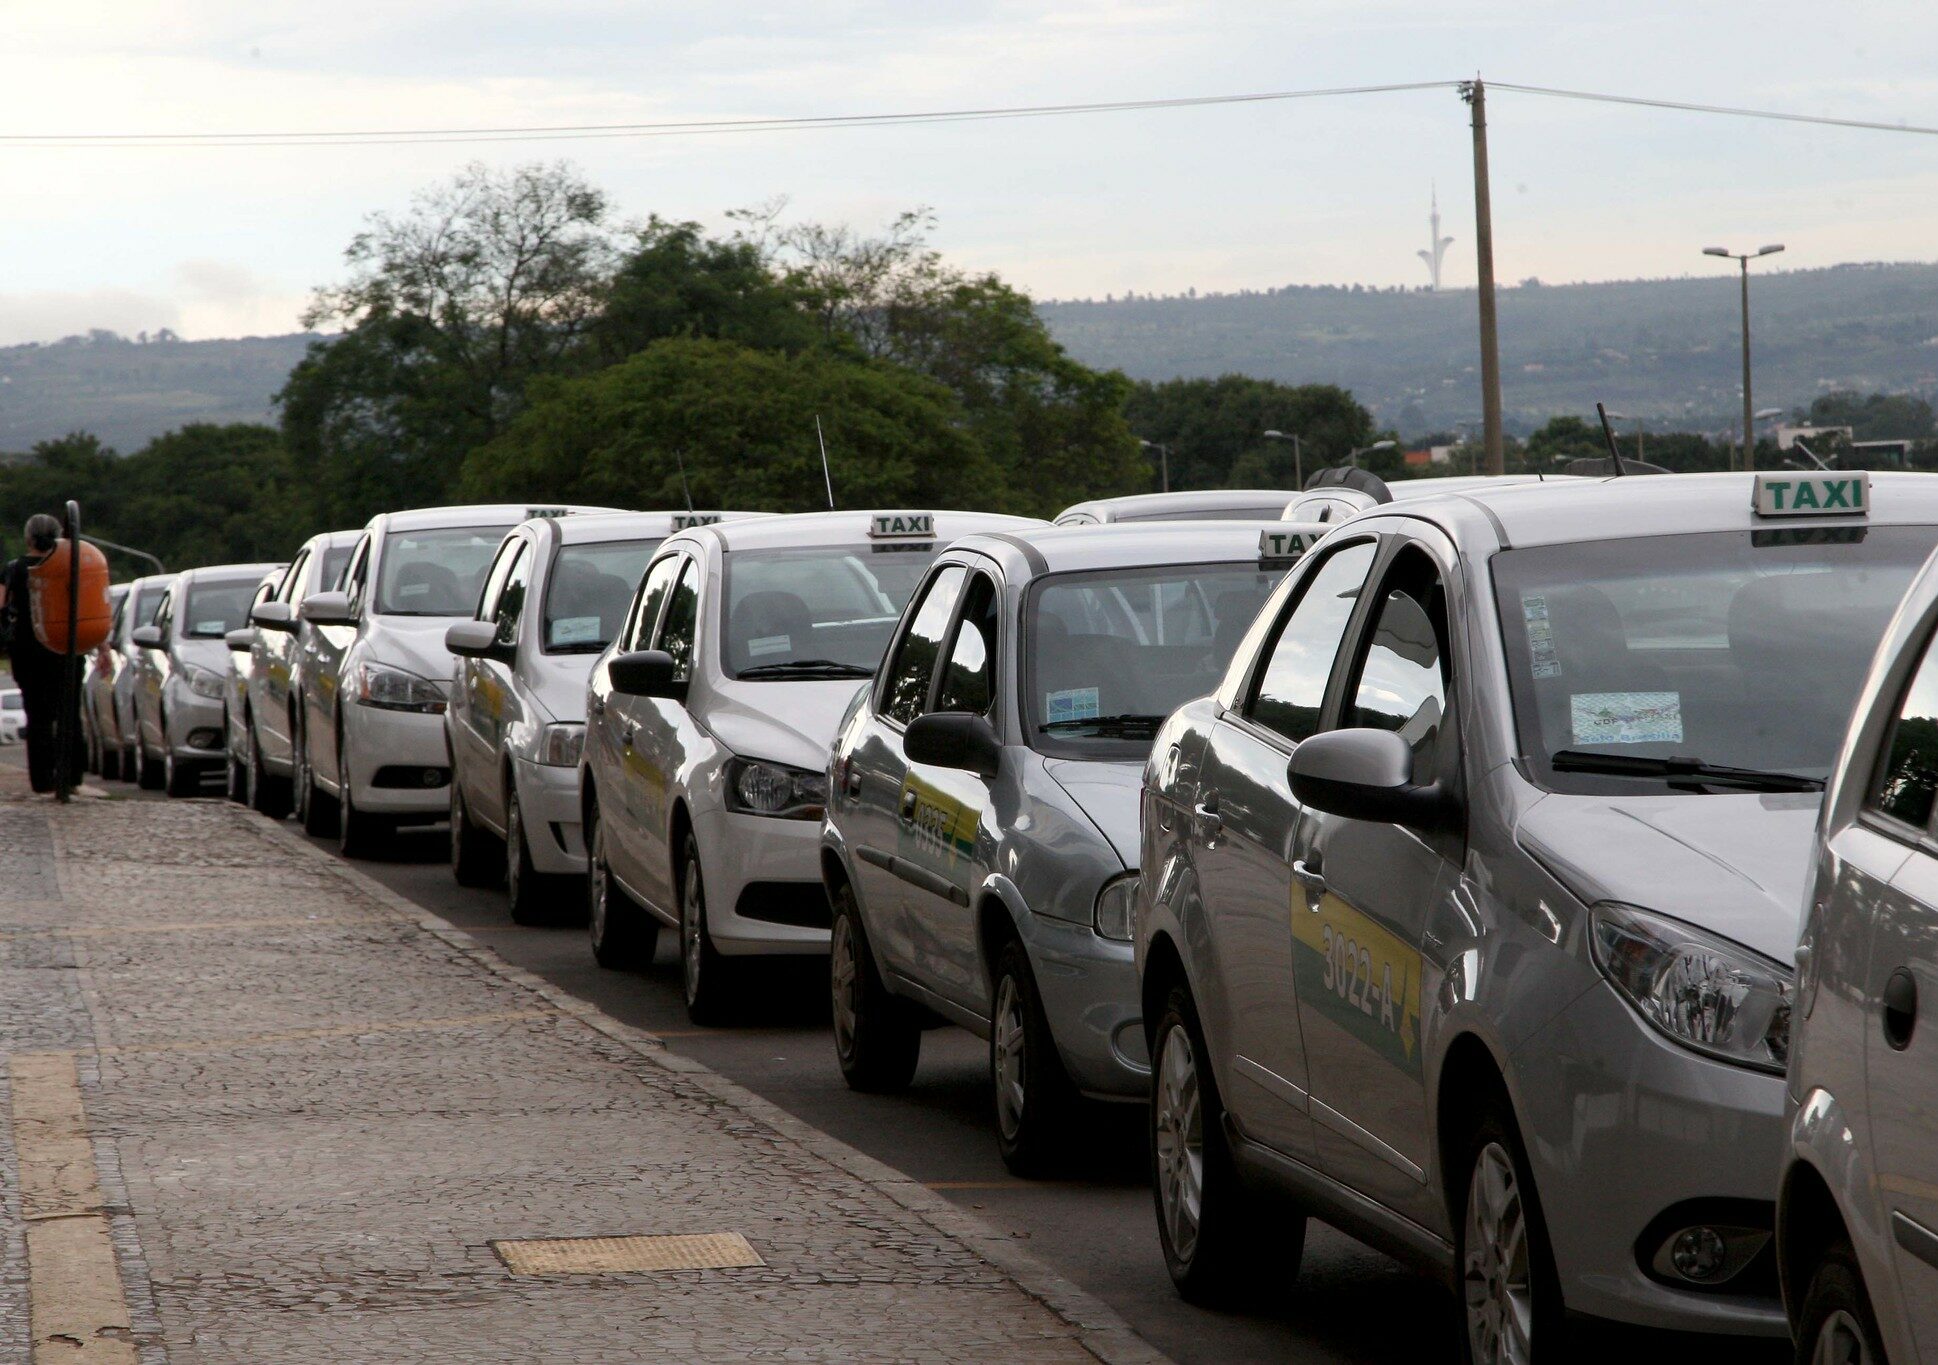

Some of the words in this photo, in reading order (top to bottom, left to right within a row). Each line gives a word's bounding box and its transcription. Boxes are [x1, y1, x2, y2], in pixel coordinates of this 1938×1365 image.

[1765, 480, 1863, 510] TAXI
[528, 510, 567, 518] TAXI
[675, 515, 719, 529] TAXI
[877, 516, 930, 532] TAXI
[1269, 533, 1323, 554] TA
[1322, 923, 1395, 1032] 3022-A
